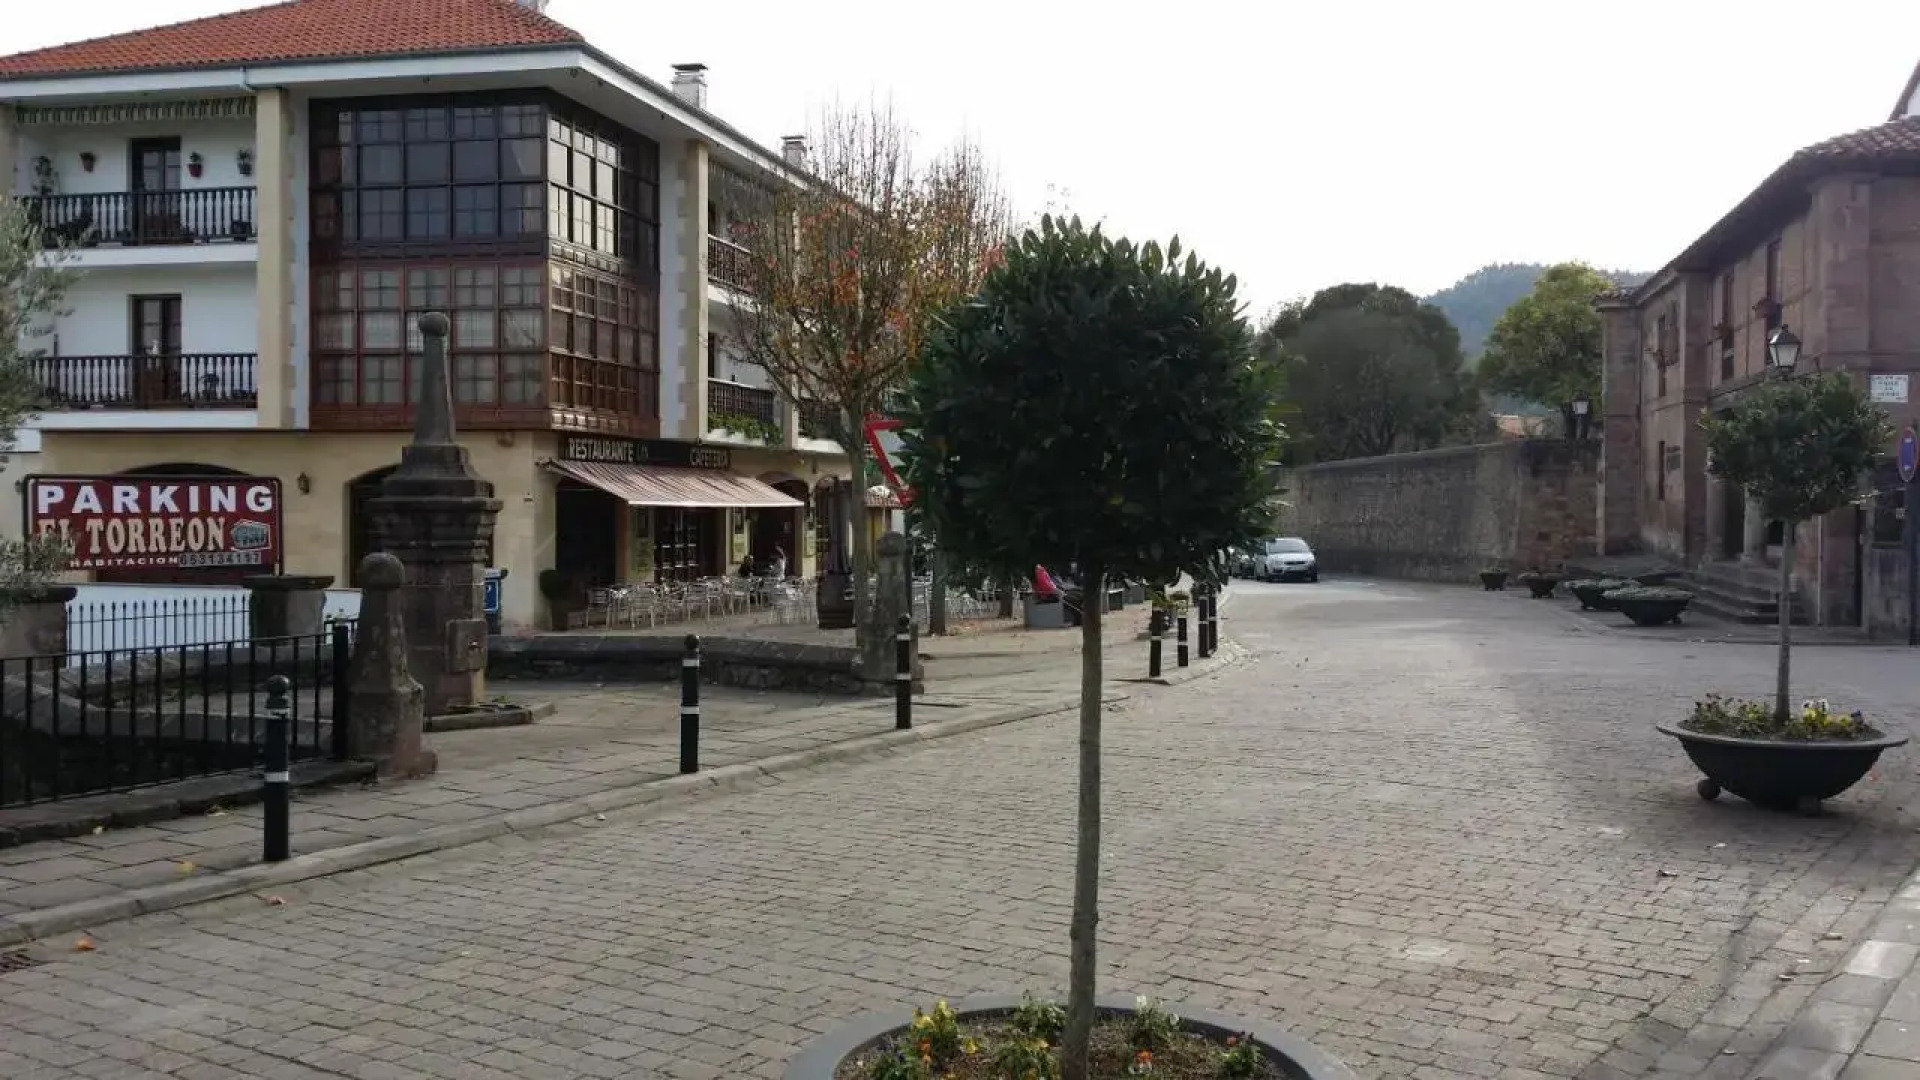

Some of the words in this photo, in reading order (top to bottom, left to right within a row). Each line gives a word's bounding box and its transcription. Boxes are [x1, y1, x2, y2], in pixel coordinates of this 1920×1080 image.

[568, 438, 634, 463] RESTAURANTE
[37, 485, 273, 514] PARKING
[86, 517, 225, 555] TORREON
